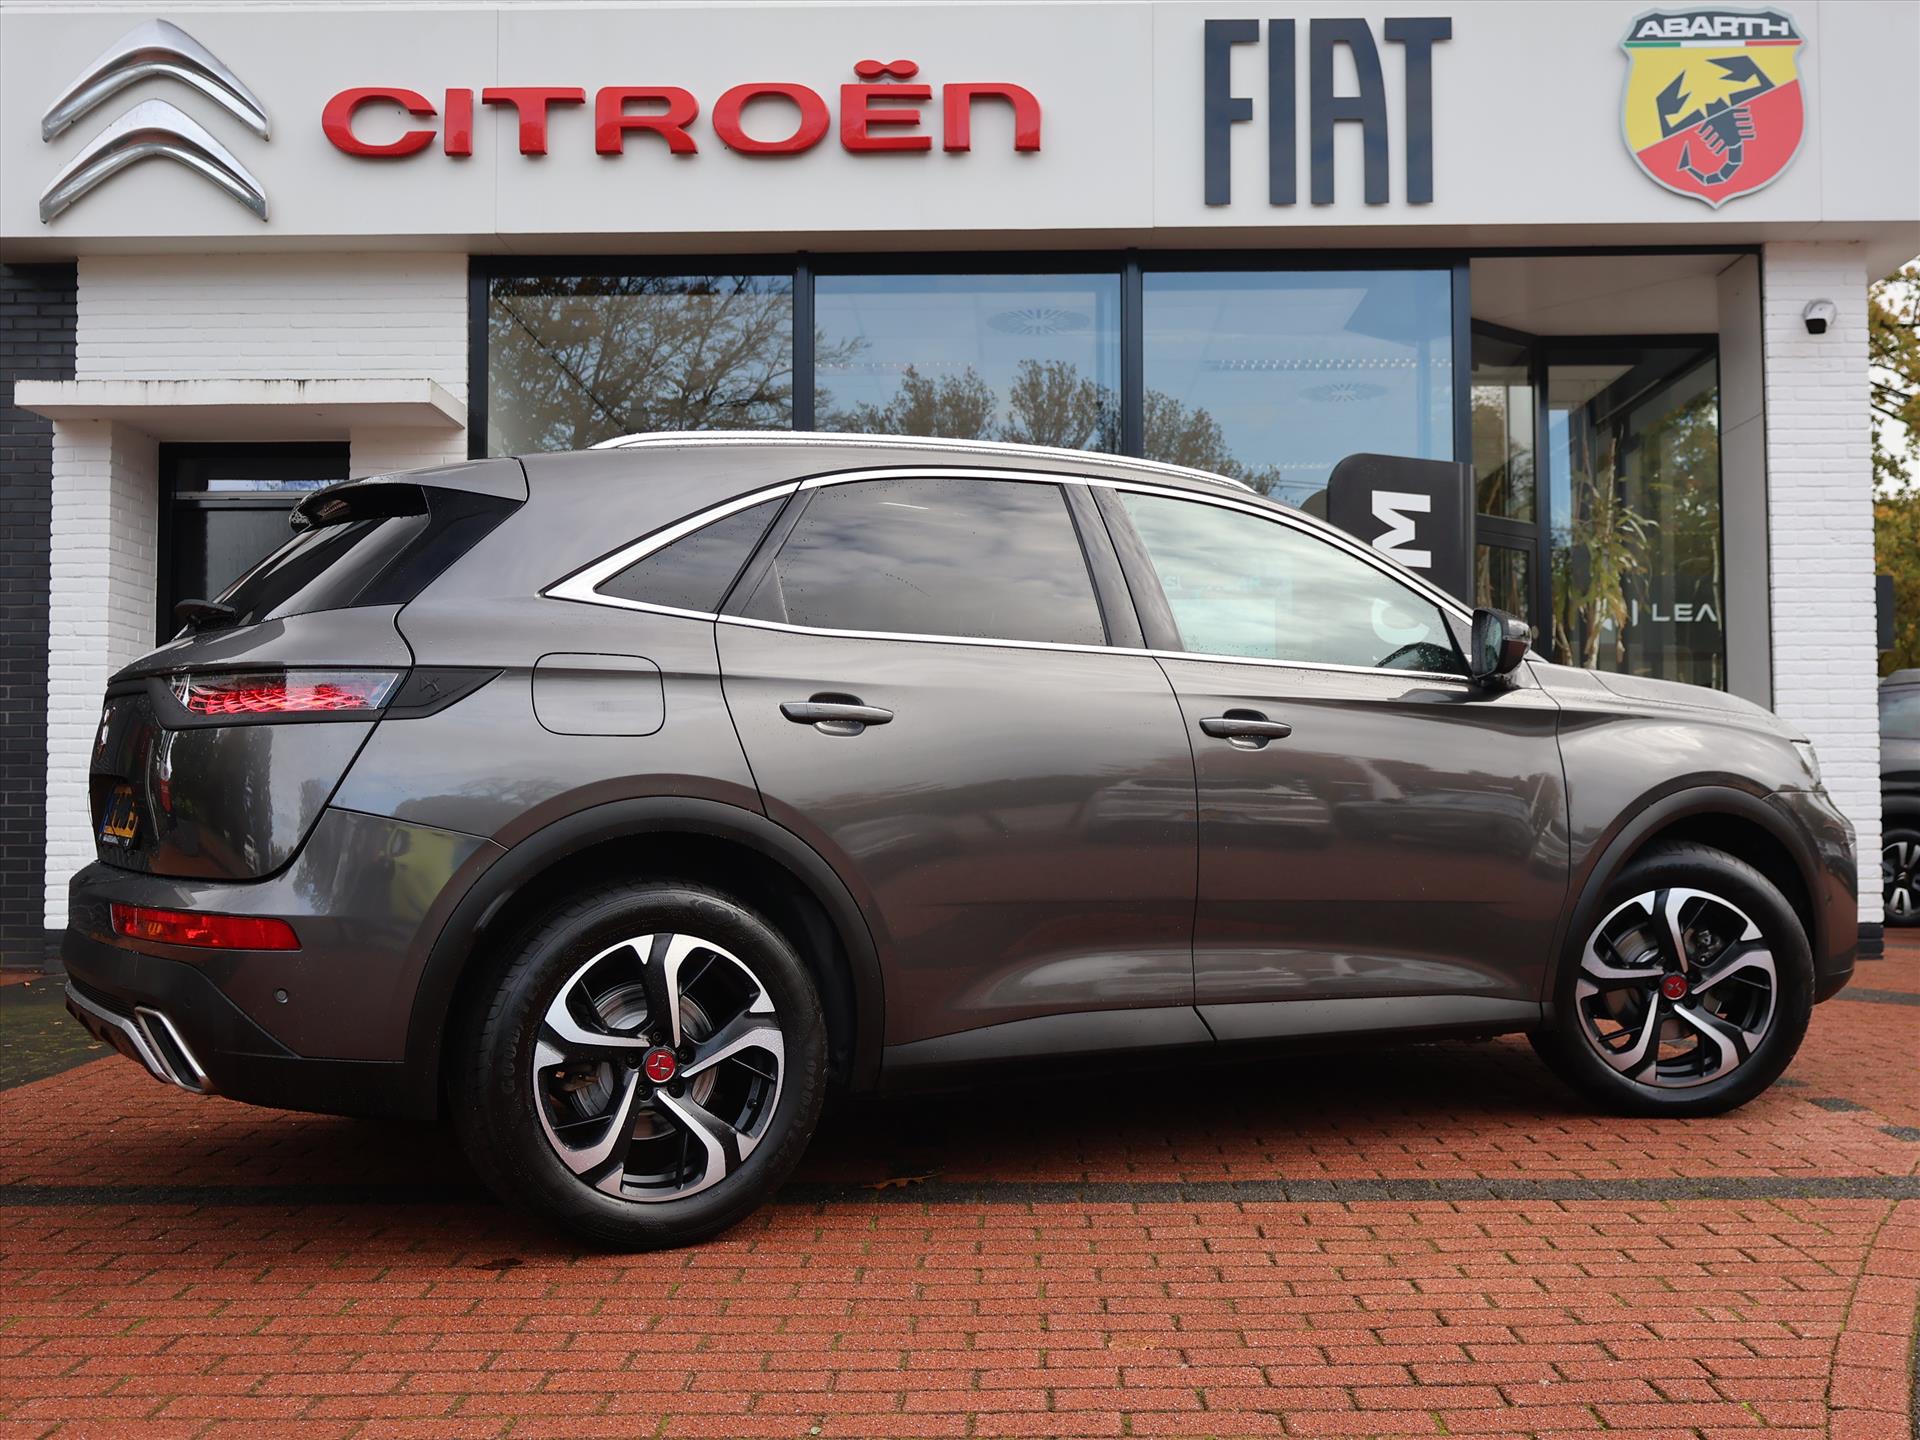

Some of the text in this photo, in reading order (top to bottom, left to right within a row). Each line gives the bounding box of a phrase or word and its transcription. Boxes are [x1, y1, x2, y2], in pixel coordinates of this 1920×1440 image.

[1636, 16, 1789, 38] ABARTH
[322, 59, 1042, 158] CITROËN
[1205, 17, 1452, 207] FIAT
[1652, 603, 1717, 622] LEA
